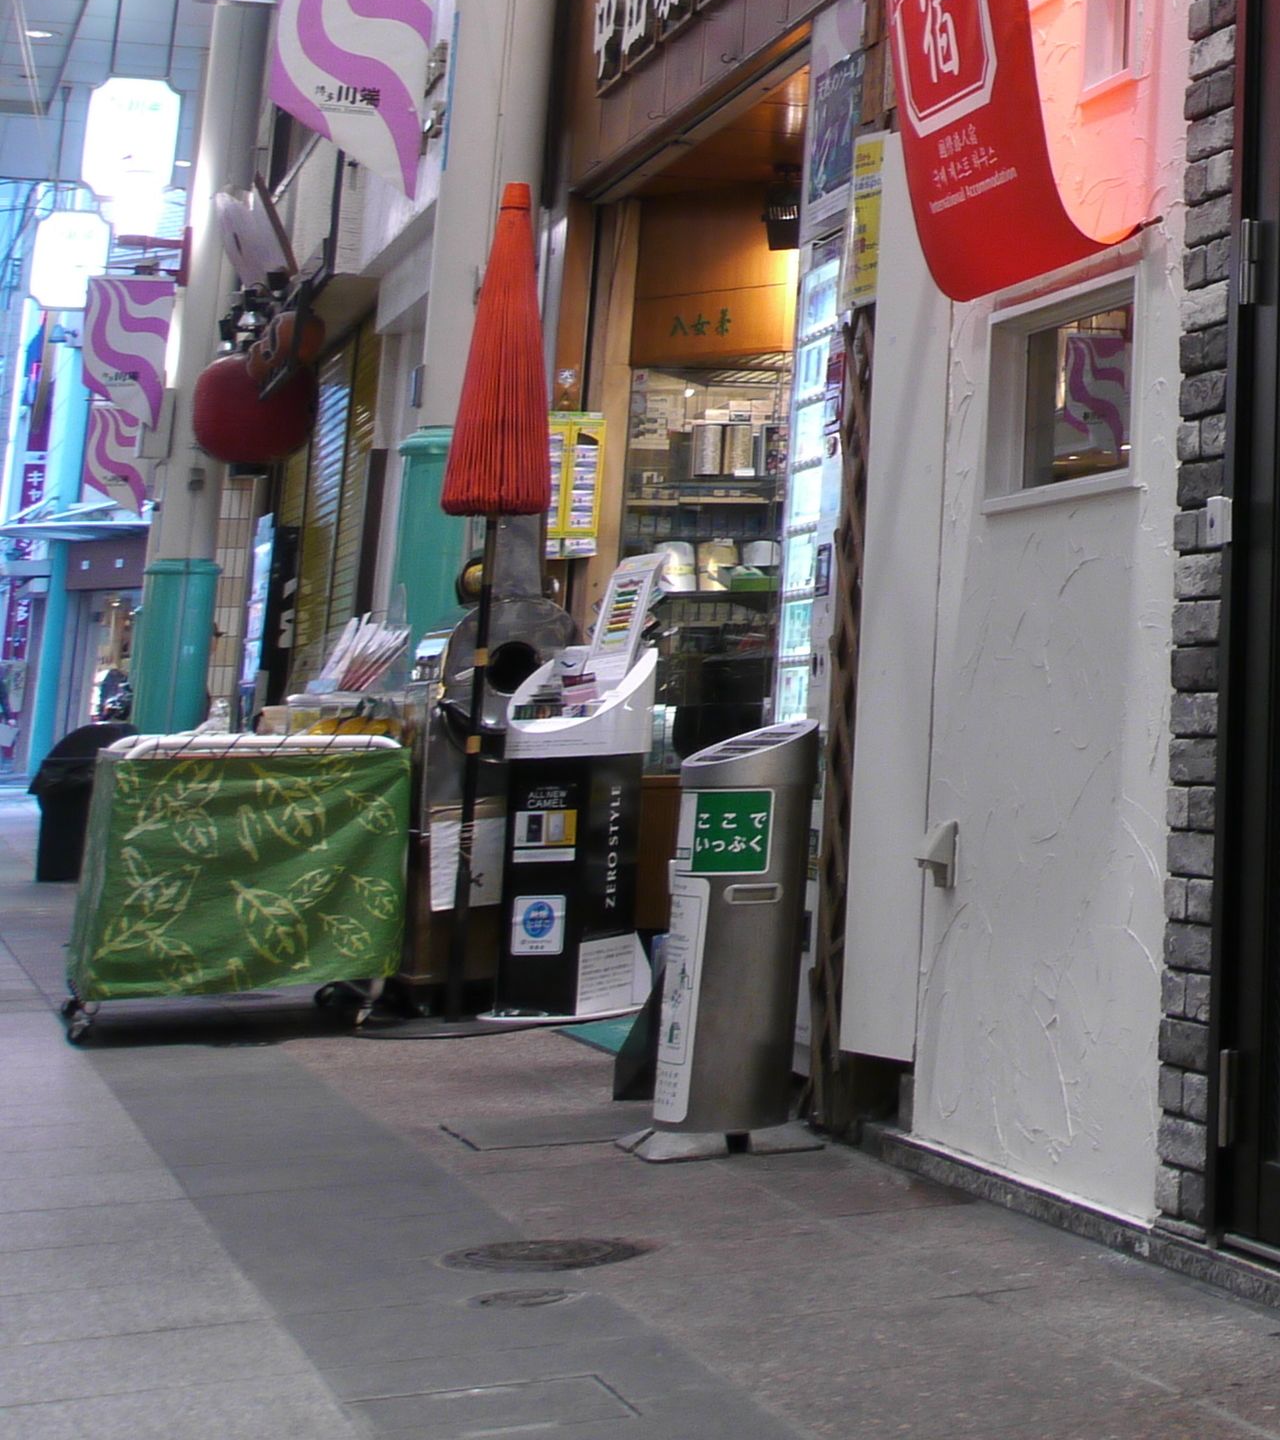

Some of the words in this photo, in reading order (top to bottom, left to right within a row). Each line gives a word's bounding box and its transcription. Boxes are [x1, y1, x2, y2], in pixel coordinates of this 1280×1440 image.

[527, 799, 567, 809] CAMEL
[609, 785, 622, 846] STYLE
[697, 812, 768, 829] ここで
[695, 835, 763, 853] いっぷく
[605, 852, 618, 908] ZERO
